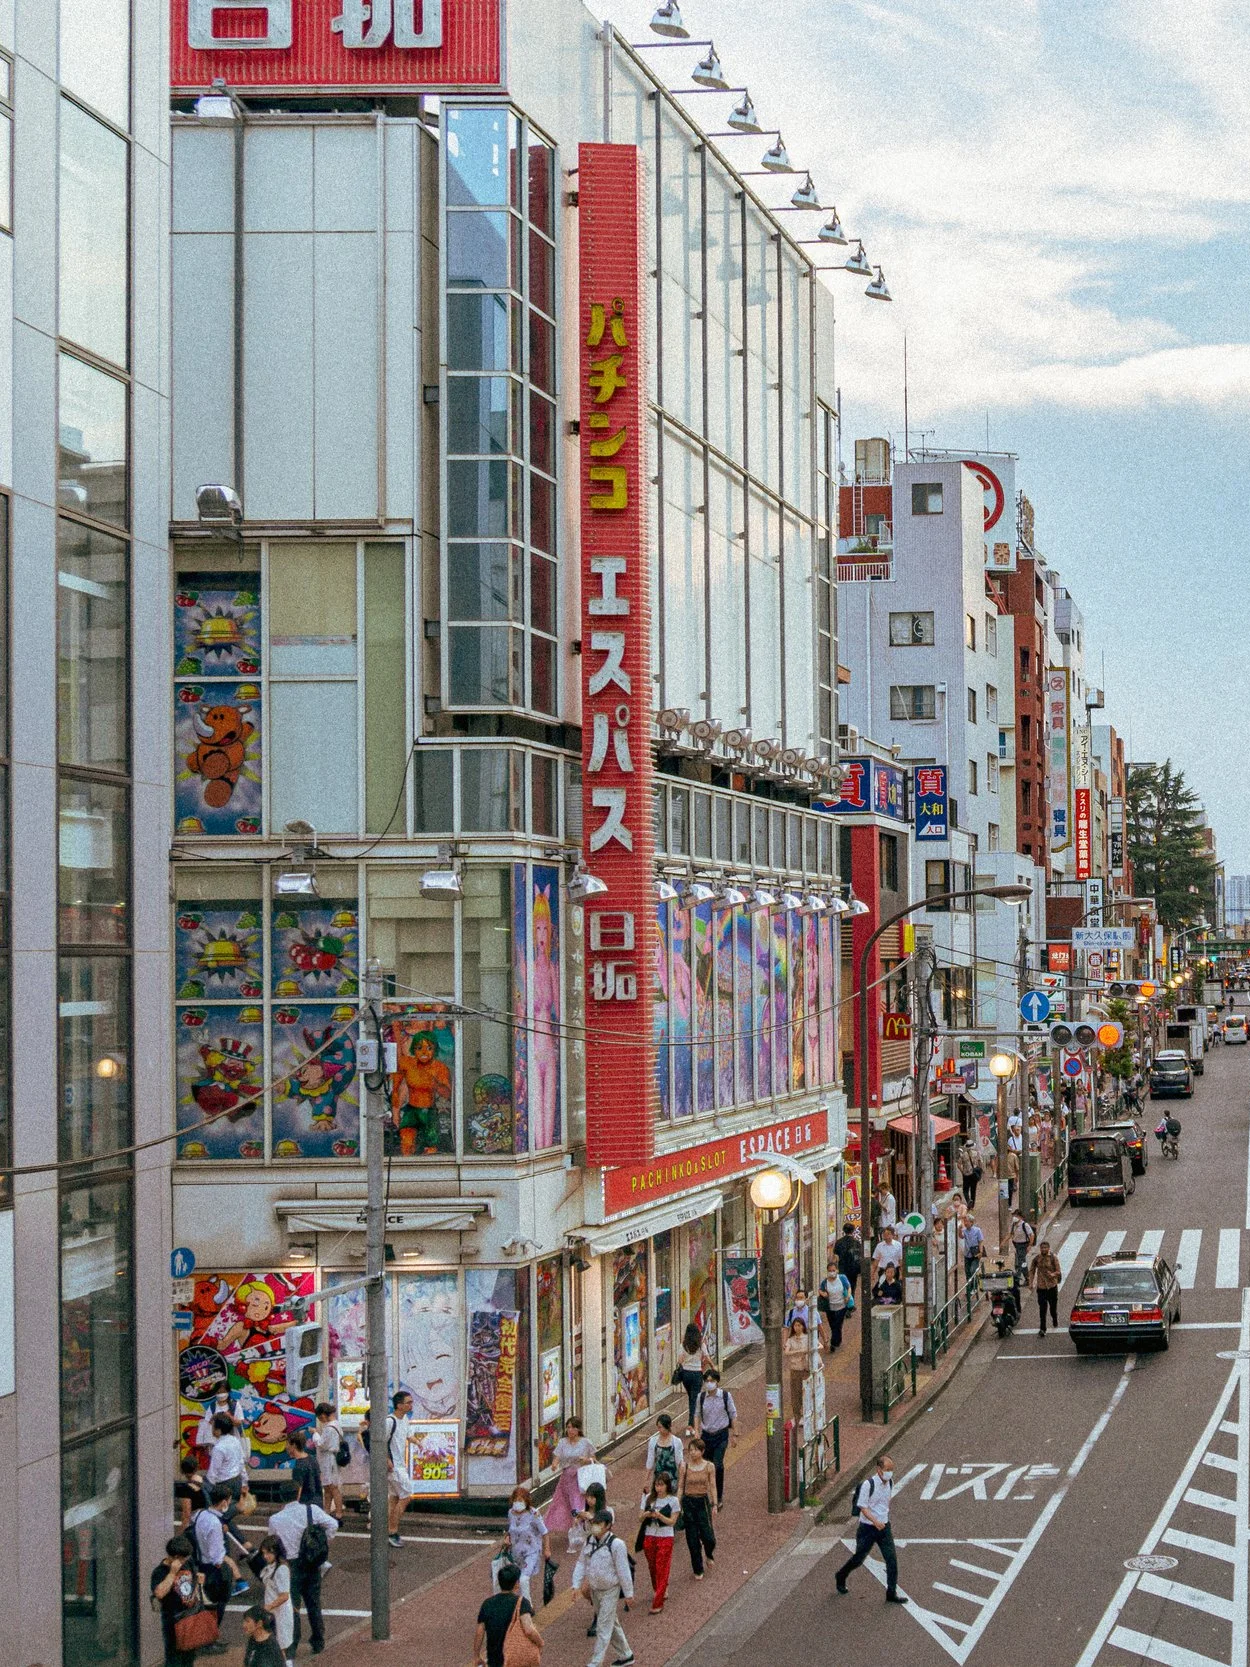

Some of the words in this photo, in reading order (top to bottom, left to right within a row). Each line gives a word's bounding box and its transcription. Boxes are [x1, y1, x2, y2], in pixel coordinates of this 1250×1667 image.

[588, 297, 628, 511] パチンコ
[588, 556, 633, 853] エスパス
[917, 768, 945, 797] 質
[920, 803, 944, 816] 大和
[927, 826, 943, 835] 入口
[589, 911, 638, 1001] 日拓
[739, 1127, 790, 1164] ESPACE
